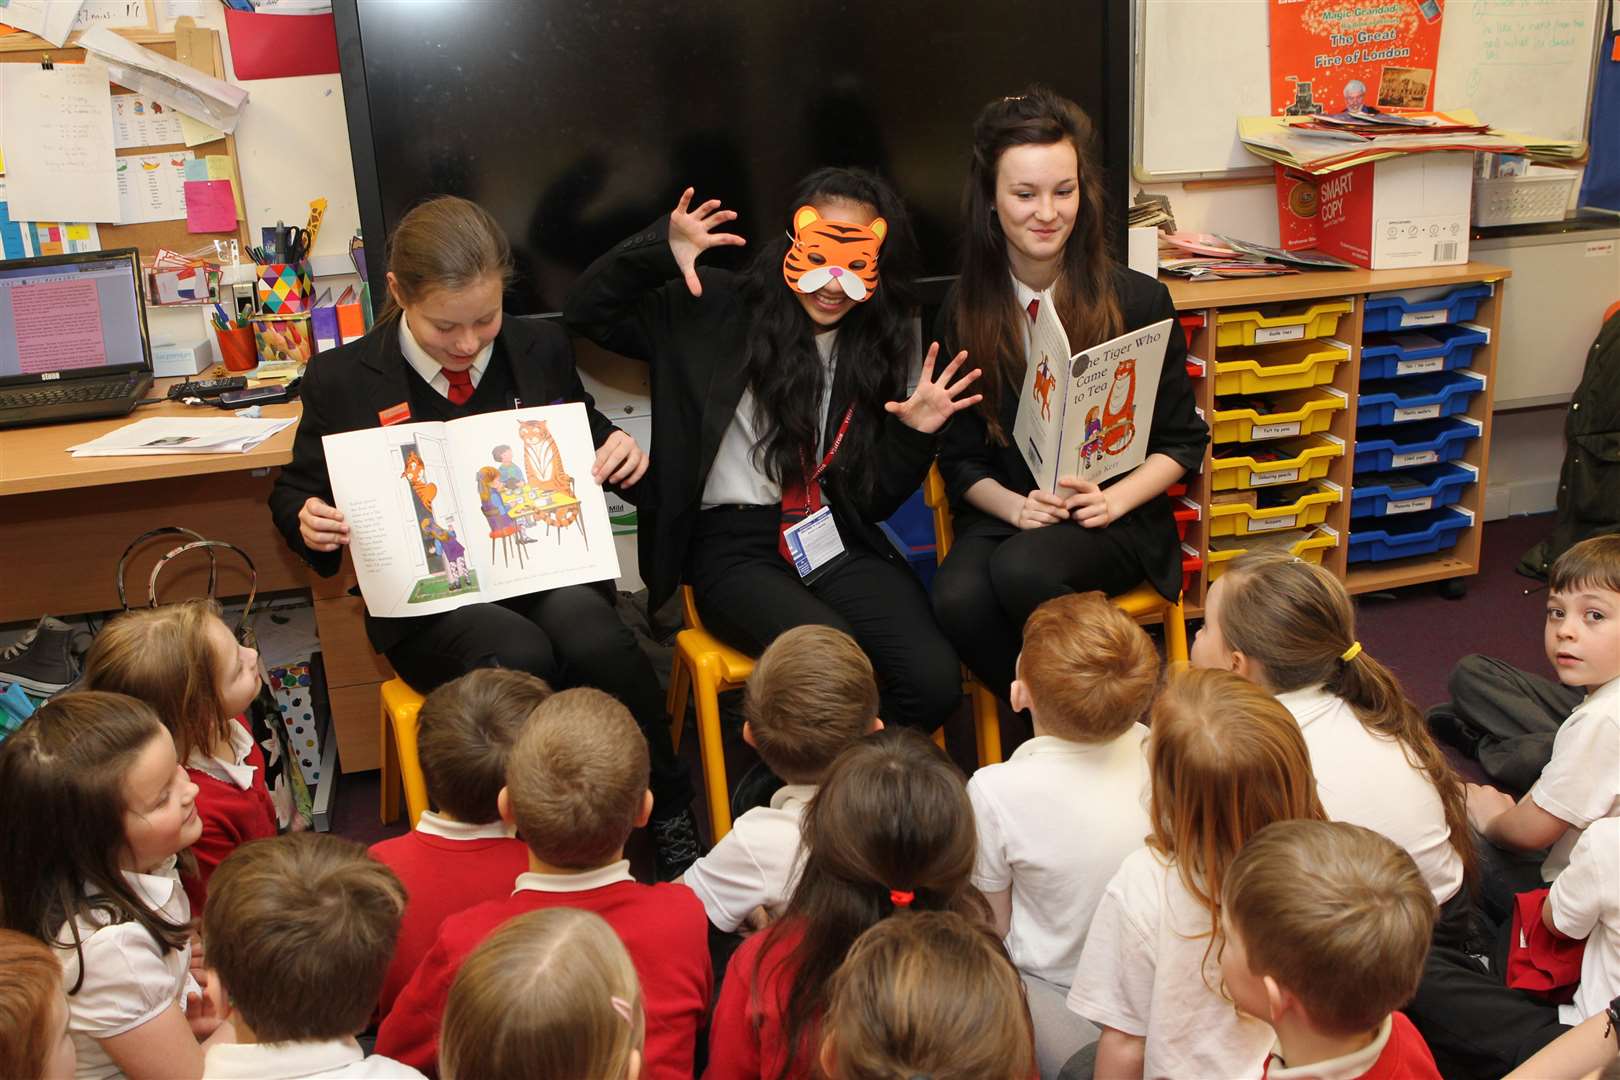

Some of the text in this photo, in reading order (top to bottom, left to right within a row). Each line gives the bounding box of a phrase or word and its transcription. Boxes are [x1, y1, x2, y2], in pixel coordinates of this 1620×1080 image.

[1322, 9, 1352, 21] Magic
[1330, 29, 1396, 47] The Great
[1314, 47, 1409, 68] Fire of London
[1320, 172, 1354, 203] SMART
[1321, 198, 1344, 221] COPY
[1087, 332, 1161, 368] he Tiger Who
[1076, 368, 1108, 388] Came
[1074, 382, 1108, 404] to Tea
[609, 504, 625, 512] Mild
